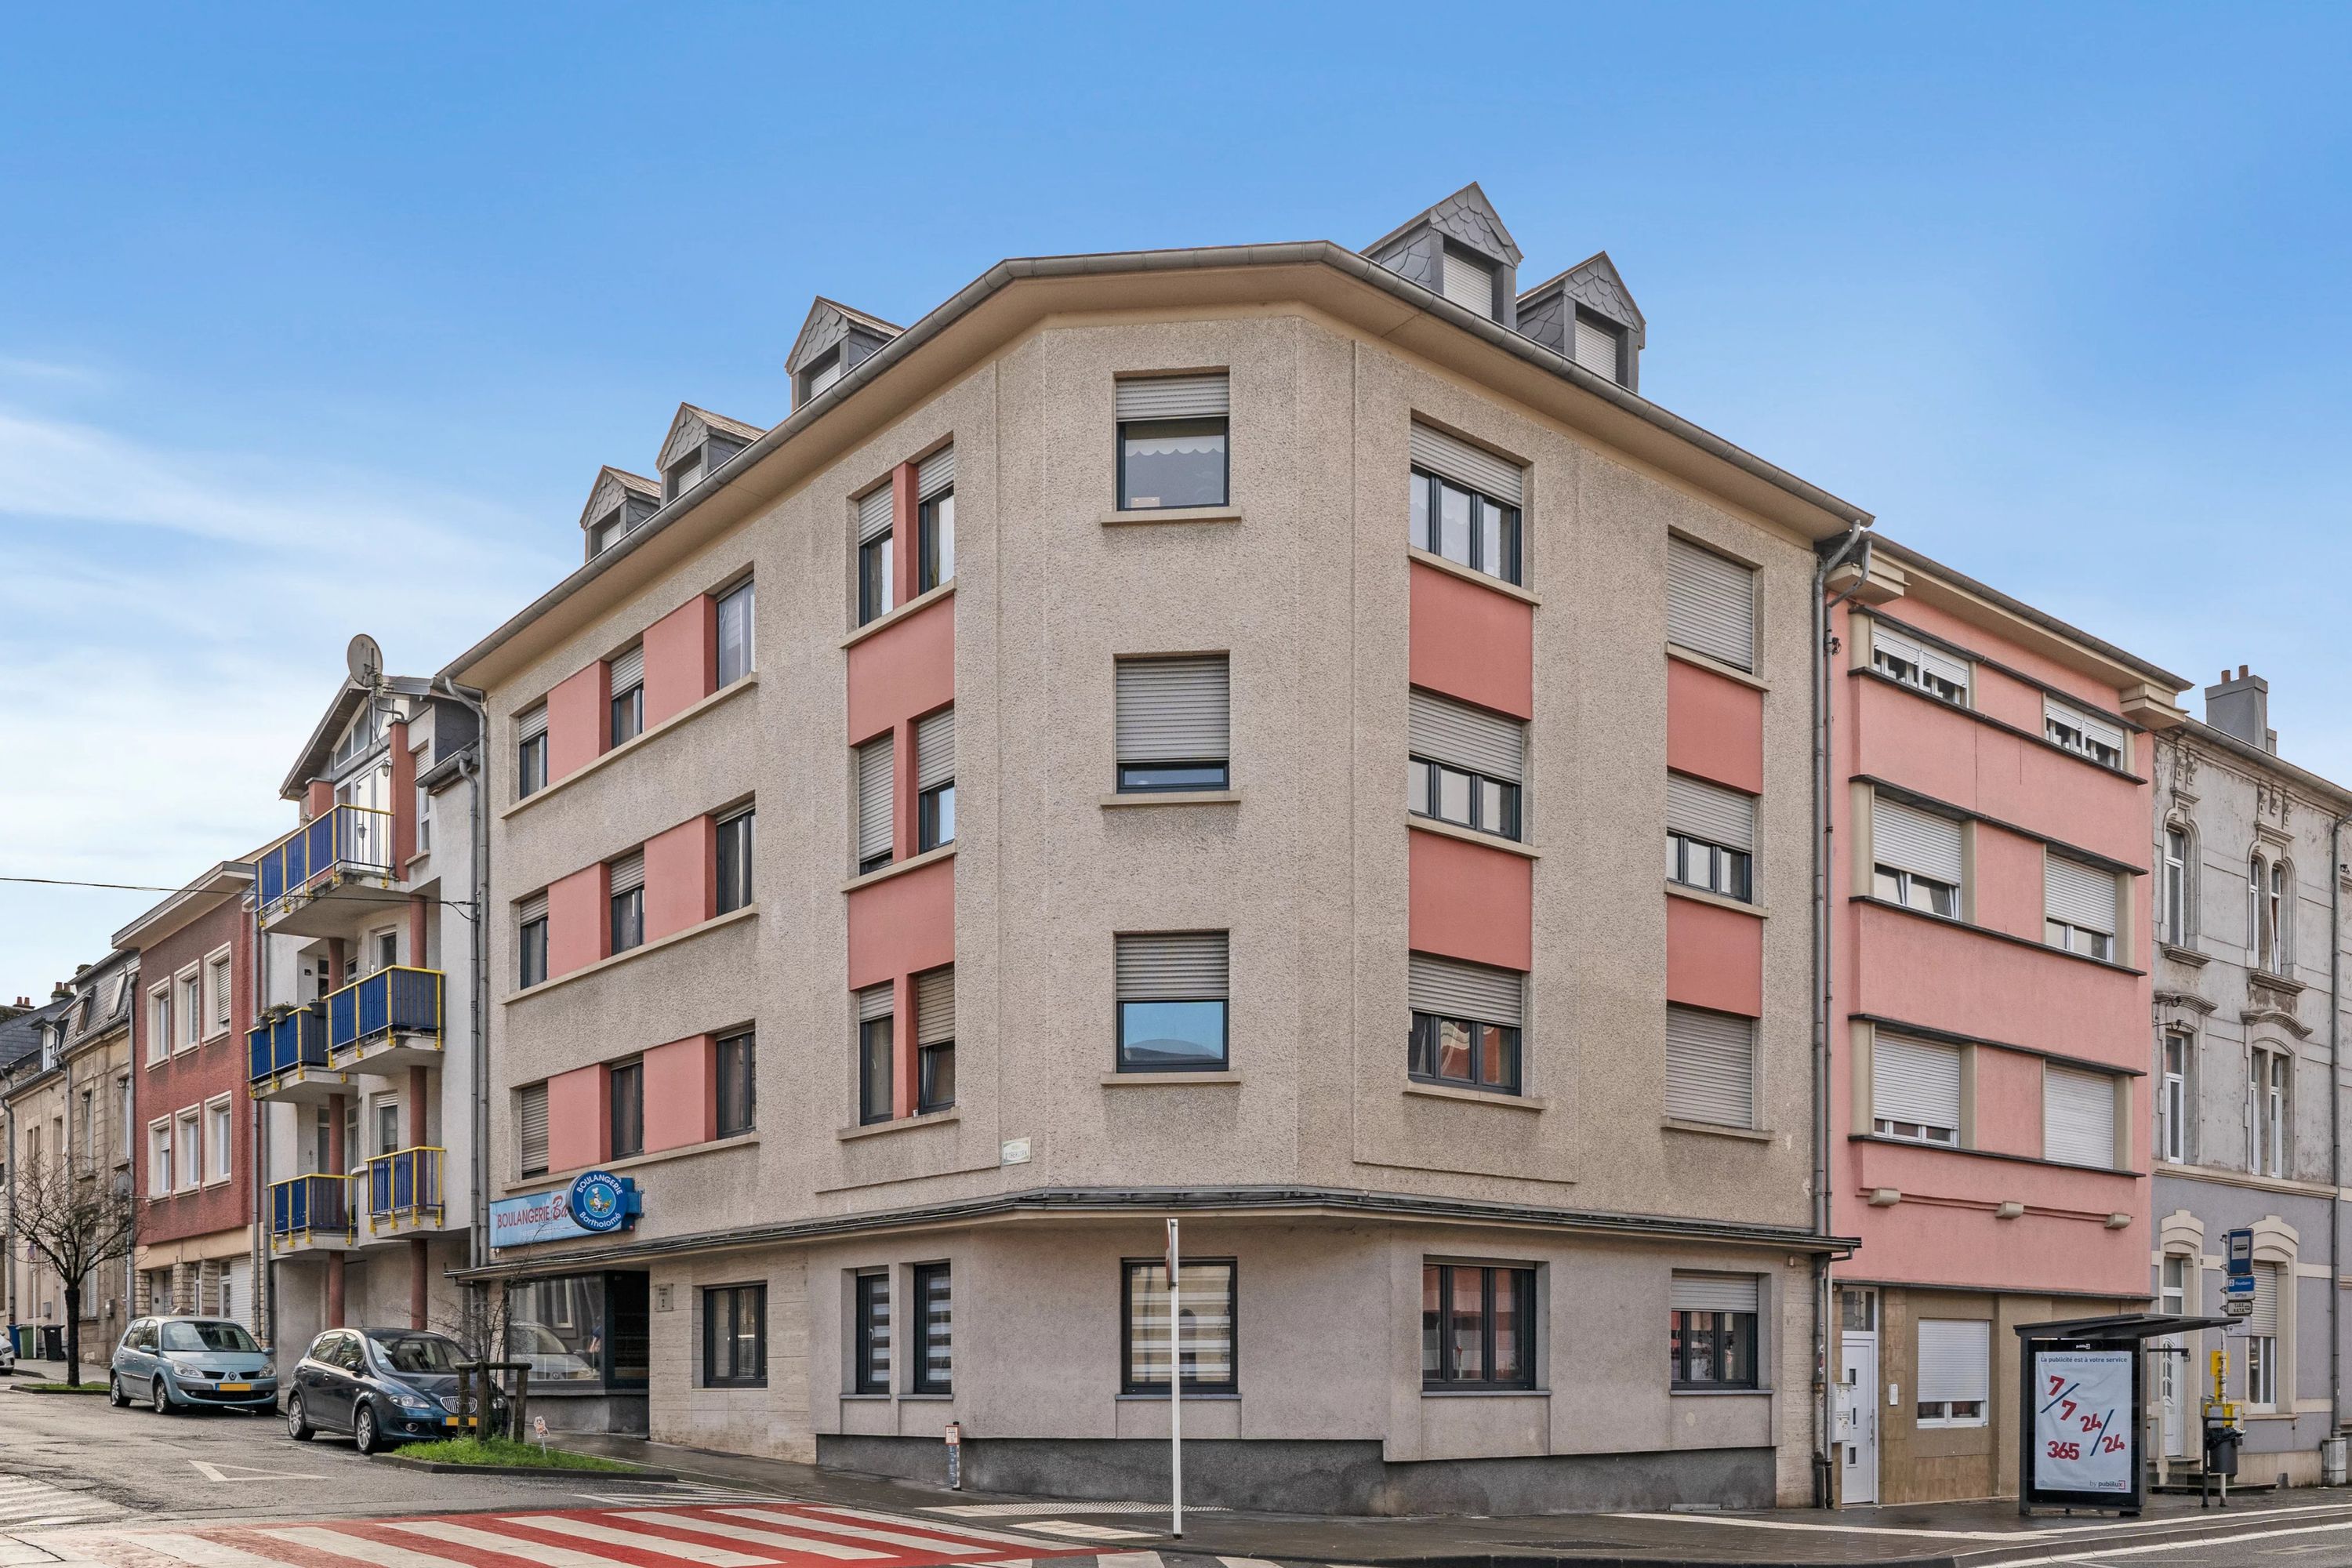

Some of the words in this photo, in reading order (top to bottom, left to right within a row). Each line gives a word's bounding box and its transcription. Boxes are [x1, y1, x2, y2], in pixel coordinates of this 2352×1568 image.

[576, 1174, 624, 1196] BOULANGERIE
[497, 1206, 550, 1229] BOULANGERIE
[551, 1194, 568, 1221] Ba
[579, 1211, 622, 1228] Bartholomé
[2047, 1440, 2080, 1461] 365
